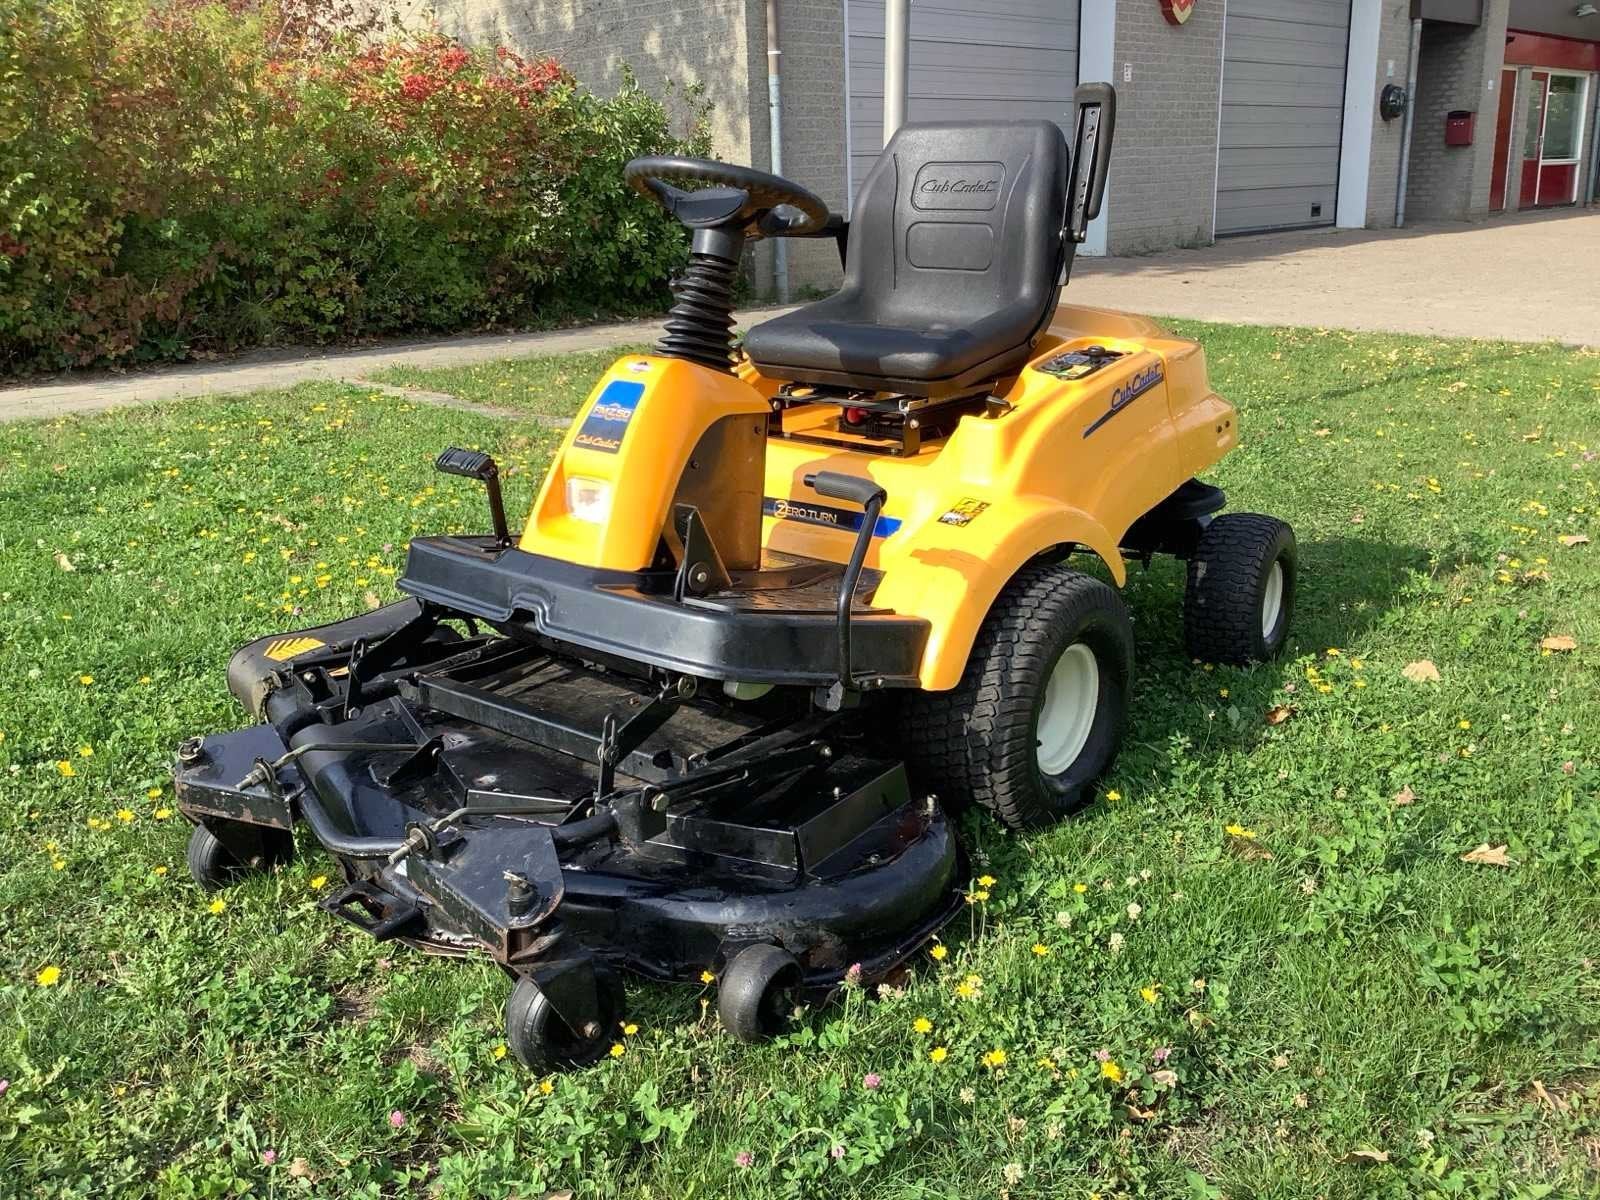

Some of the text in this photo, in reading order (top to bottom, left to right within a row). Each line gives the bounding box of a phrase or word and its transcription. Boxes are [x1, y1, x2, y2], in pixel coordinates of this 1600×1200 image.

[920, 179, 998, 193] Cub Cadet
[1111, 362, 1161, 410] Cub Cadet
[575, 434, 594, 444] Cub
[775, 501, 837, 523] ZERO TURN
